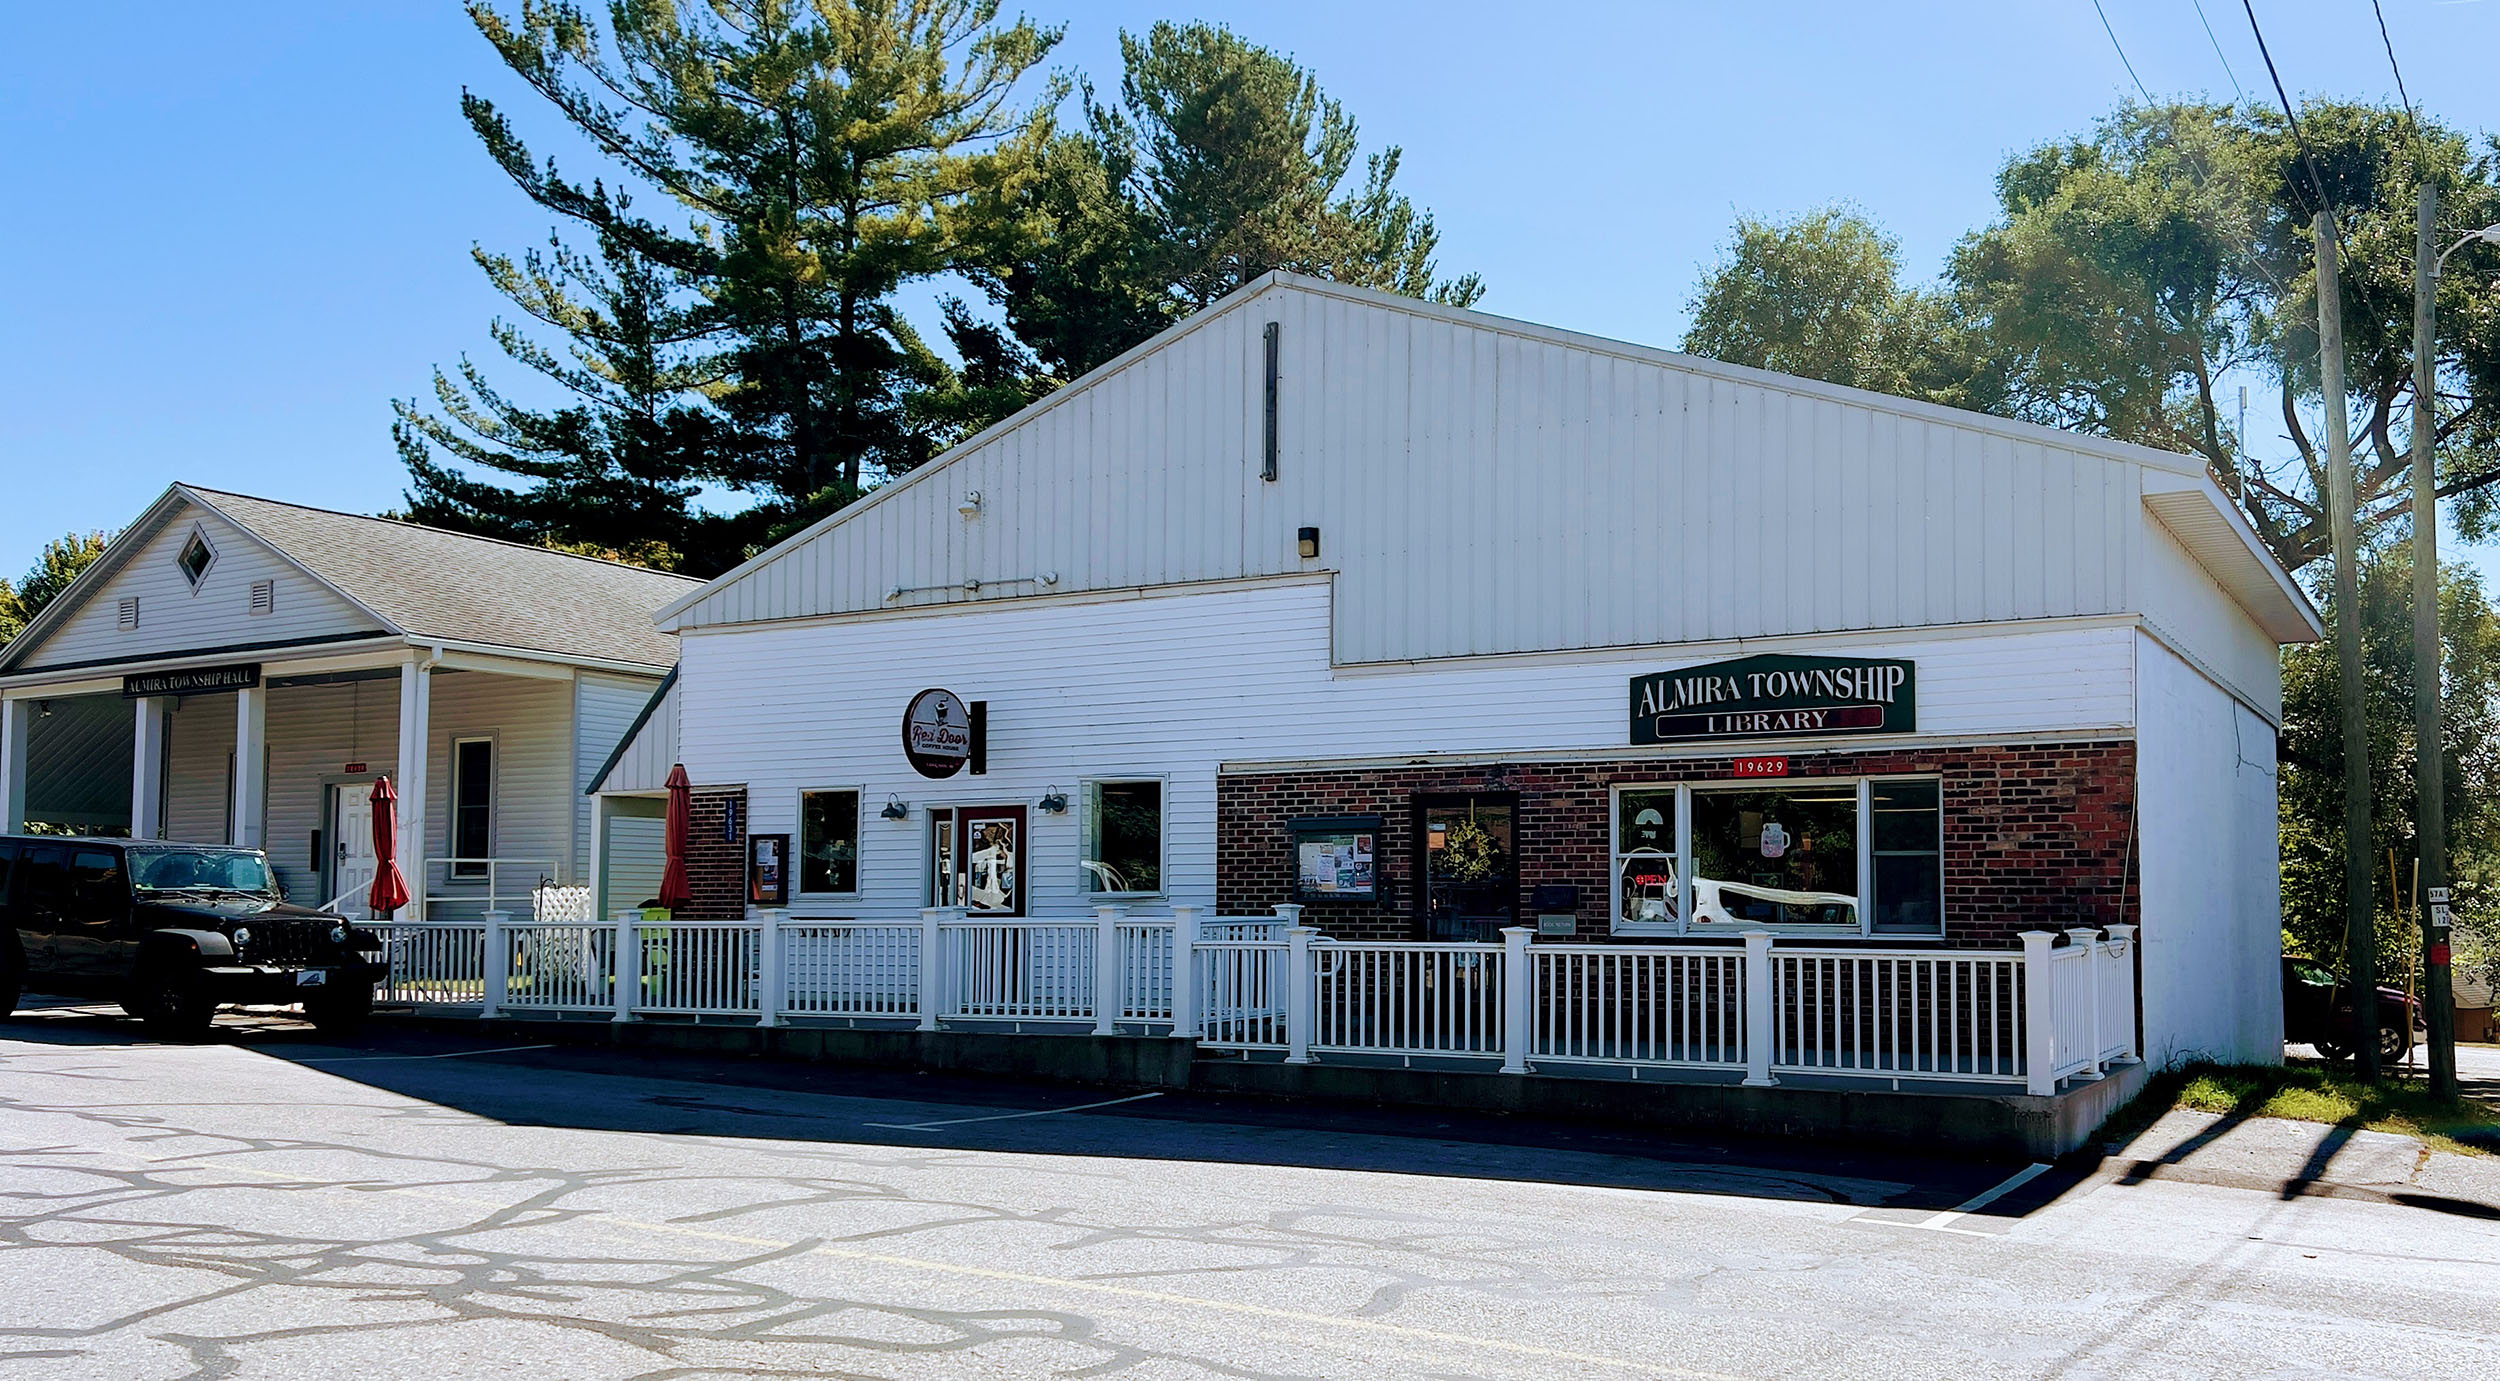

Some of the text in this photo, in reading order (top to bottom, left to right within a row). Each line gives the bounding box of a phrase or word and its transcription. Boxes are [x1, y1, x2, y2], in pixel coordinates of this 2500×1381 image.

[129, 670, 251, 693] ALMIRA TOWNSHIP HALL
[1638, 665, 1905, 718] ALMIRA TOWNSHIP
[1708, 710, 1829, 732] LIBRARY
[936, 728, 968, 745] Door
[1738, 760, 1784, 773] 19629
[1635, 874, 1667, 885] OPEN
